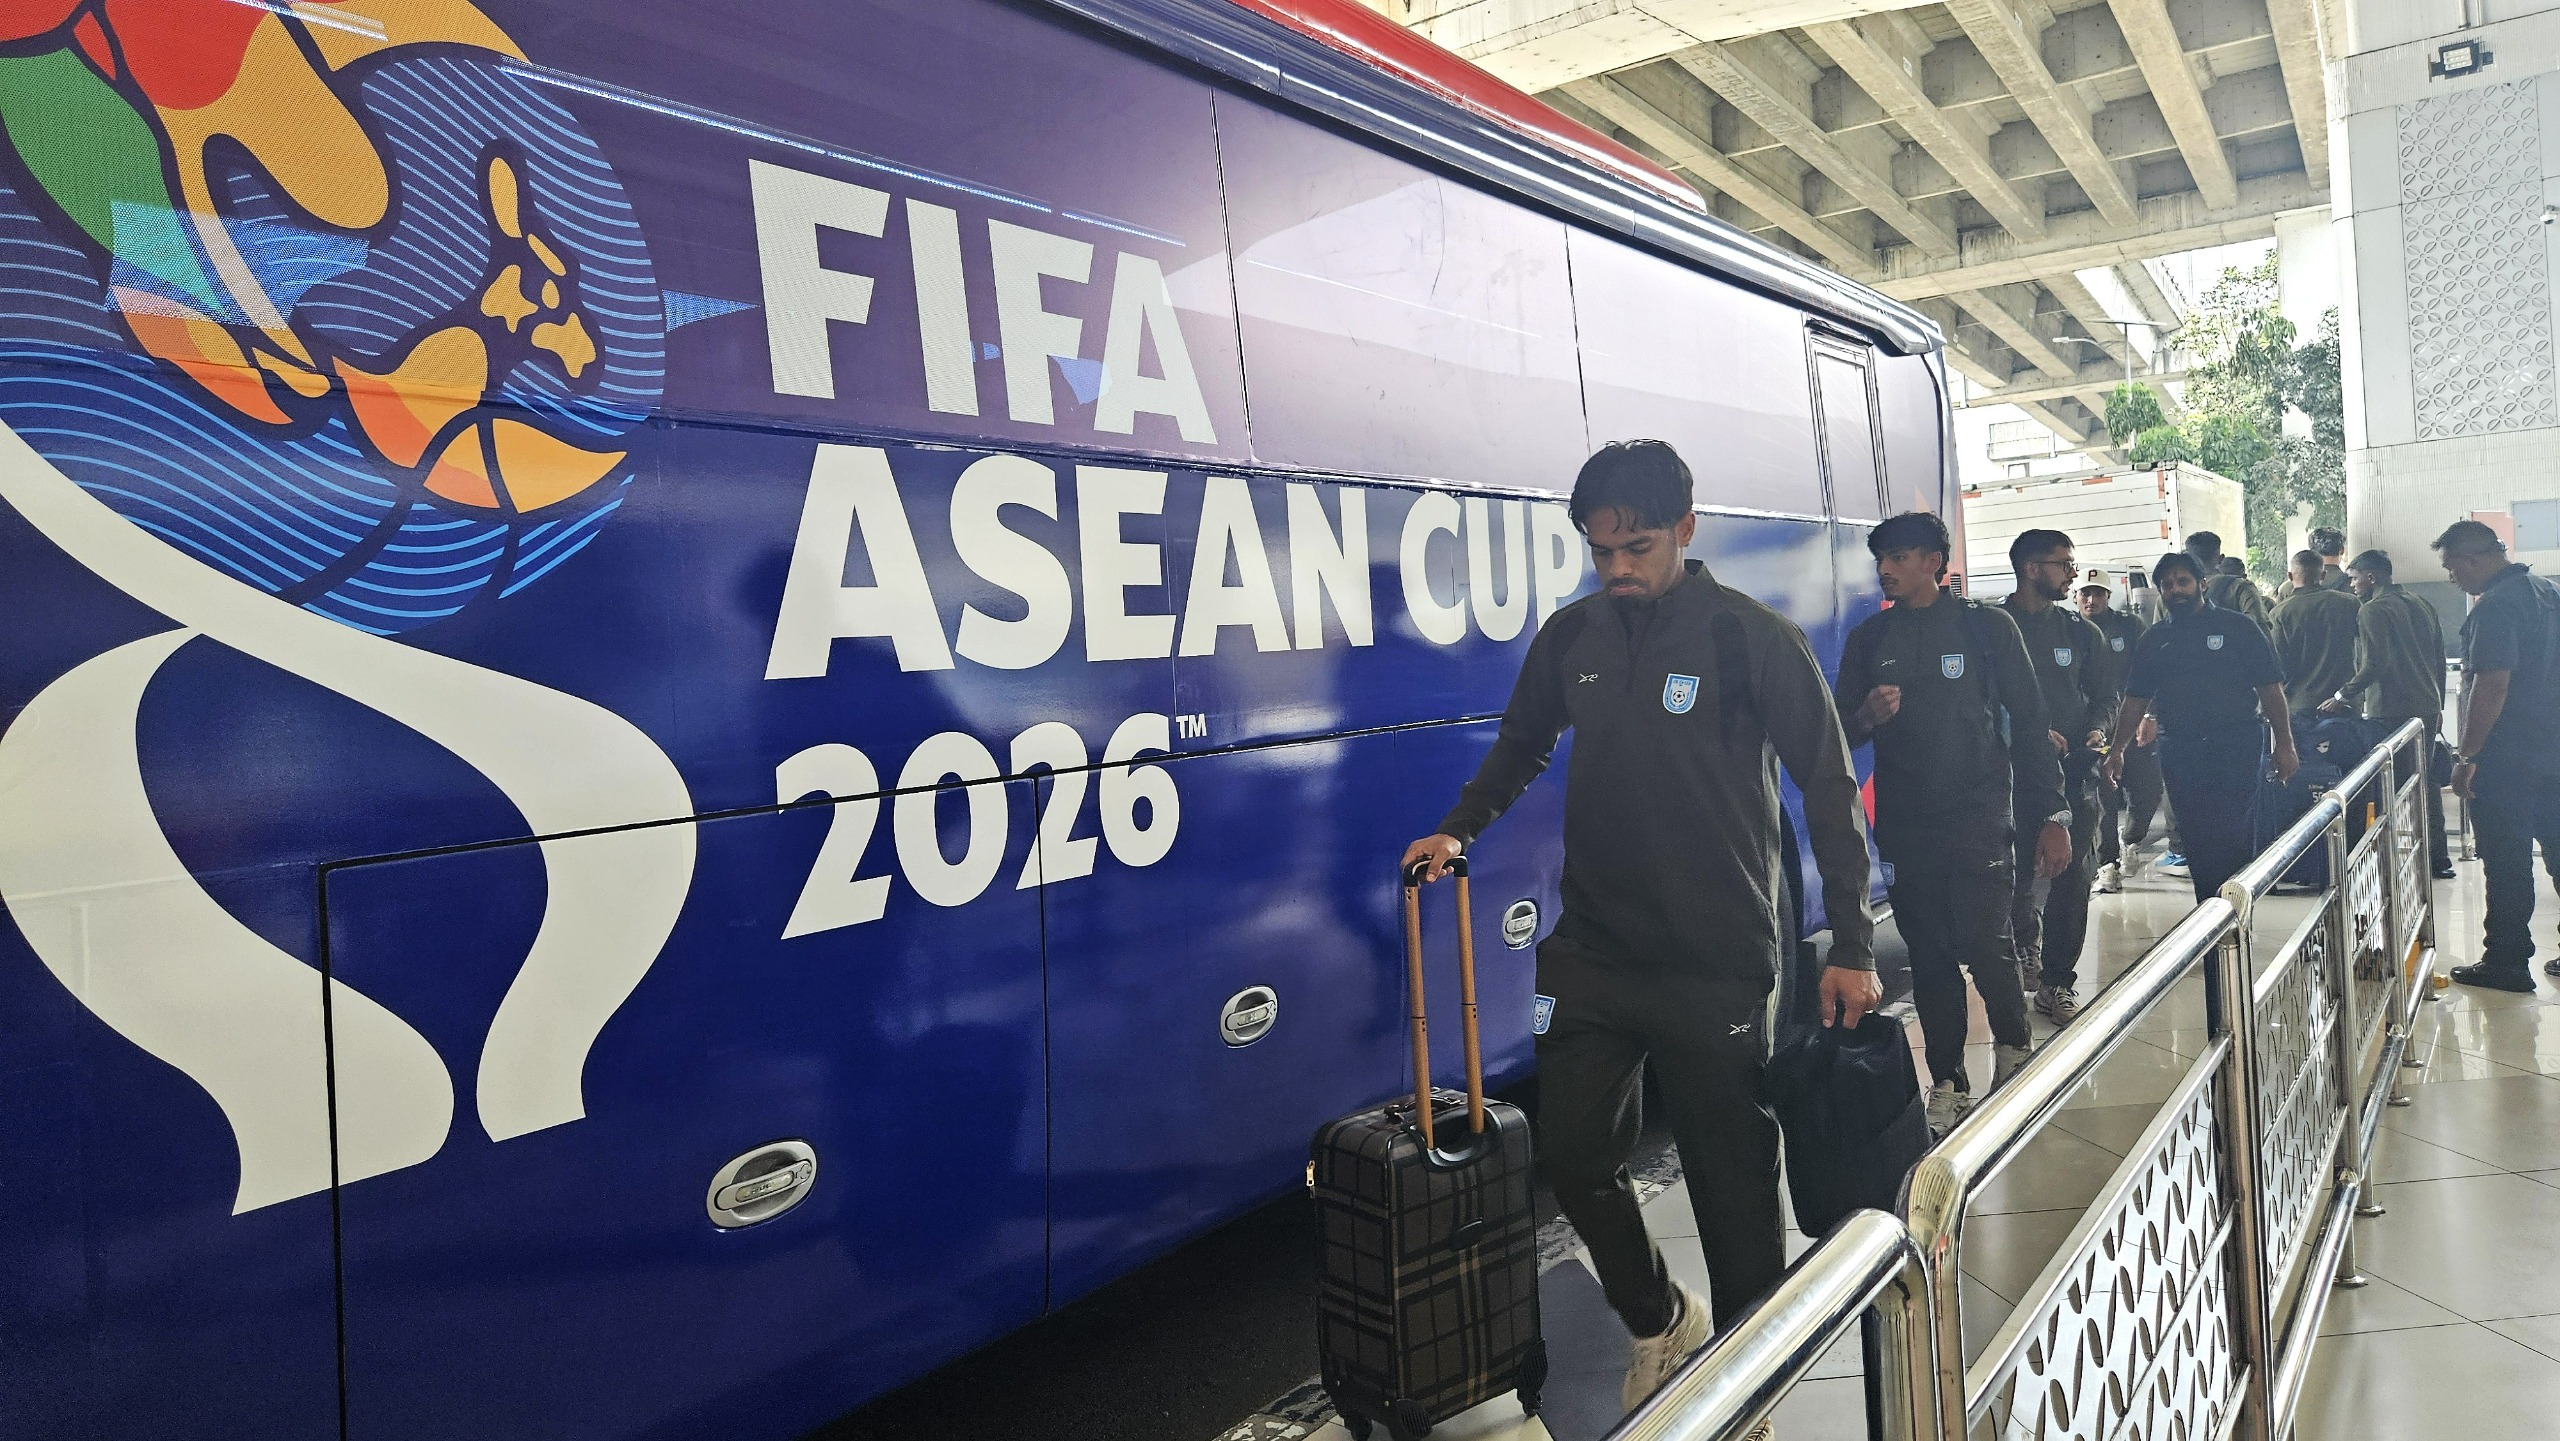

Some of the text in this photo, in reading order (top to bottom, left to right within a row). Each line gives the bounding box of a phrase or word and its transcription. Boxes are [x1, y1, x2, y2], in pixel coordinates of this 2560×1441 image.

[748, 159, 1217, 445] FIFA
[764, 443, 1583, 681] ASEAN CUP
[2087, 569, 2098, 581] P
[776, 713, 1180, 941] 2026
